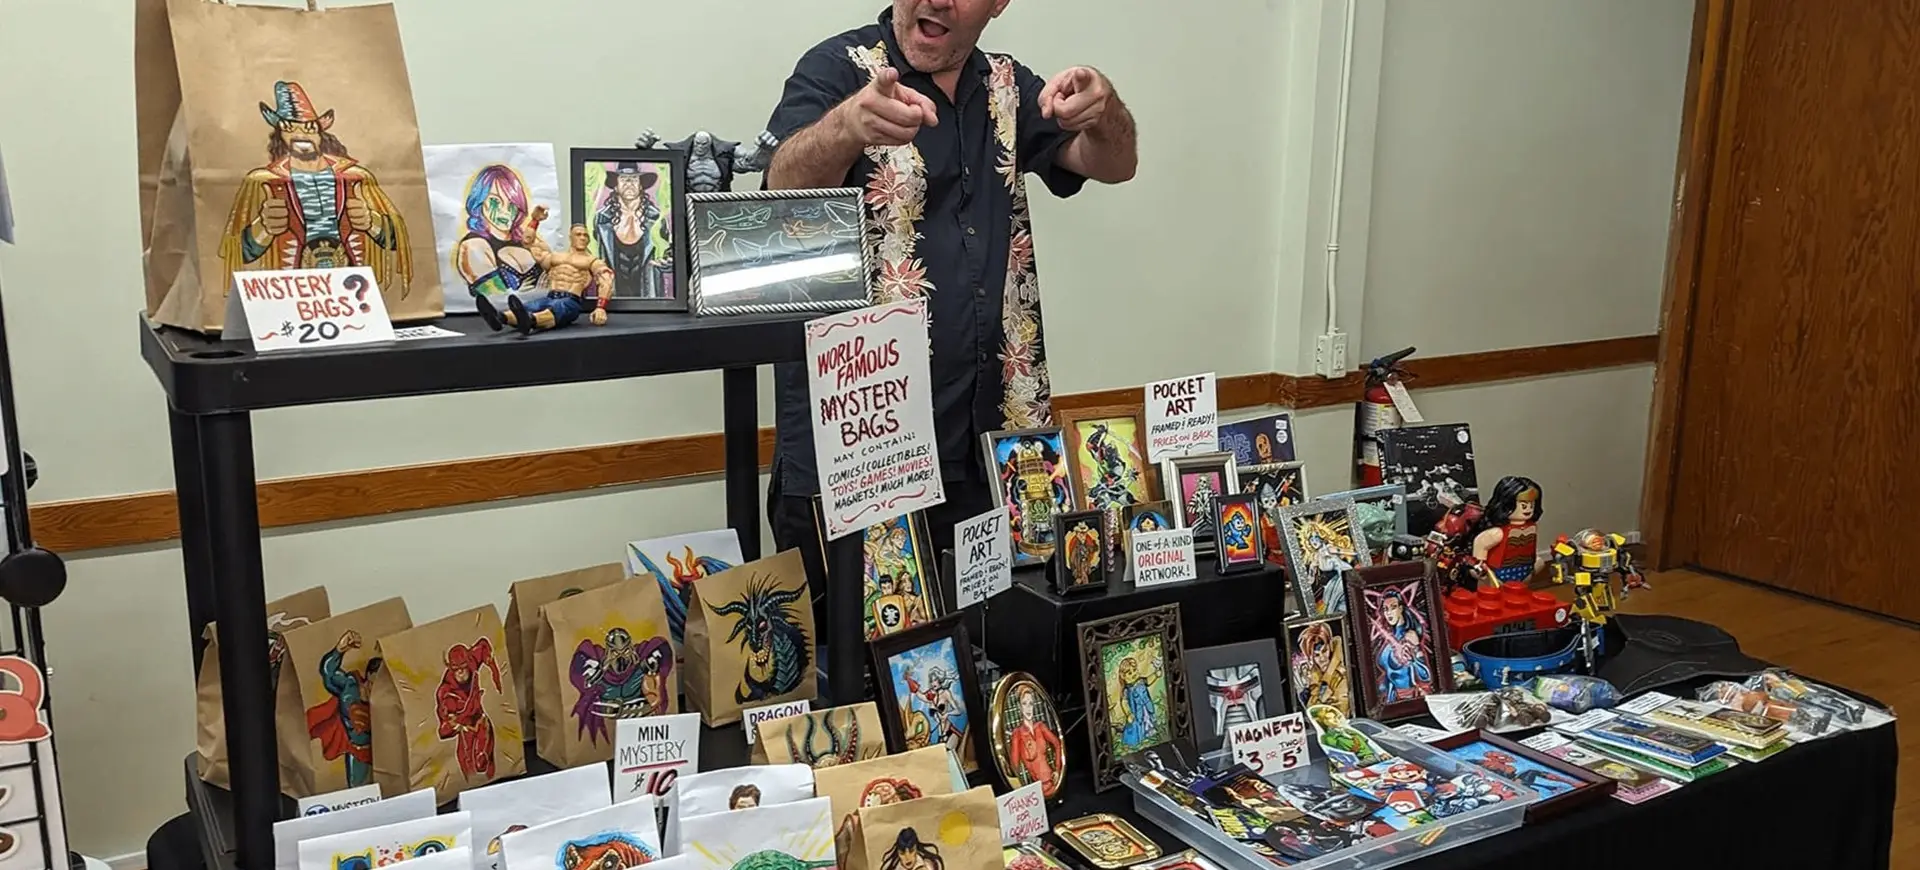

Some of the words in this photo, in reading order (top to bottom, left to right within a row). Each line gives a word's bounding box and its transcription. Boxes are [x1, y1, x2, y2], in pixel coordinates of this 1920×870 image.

[242, 273, 332, 301] MYSTERY
[297, 296, 354, 321] BAGS
[817, 336, 865, 378] WORLD
[837, 338, 900, 391] FAMOUS
[820, 375, 909, 426] MYSTERY
[1153, 376, 1205, 400] POCKET
[1165, 397, 1197, 417] ART
[840, 410, 900, 447] BAGS
[1151, 421, 1181, 435] FRAMED
[1187, 413, 1215, 428] READY!
[833, 451, 855, 465] MAY
[861, 431, 916, 457] CONTAIN:
[1153, 434, 1178, 448] PRICES
[1192, 430, 1214, 441] BACK
[828, 462, 865, 487] COMICS!
[866, 443, 931, 473] COLLECTIBLES!
[831, 478, 859, 498] TOYS!
[860, 467, 897, 489] GAMES!
[898, 455, 933, 476] MOVIES!
[834, 484, 879, 511] MAGNETS!
[880, 480, 904, 494] MUCH
[906, 468, 934, 485] MORE!
[962, 514, 1003, 546] POCKET
[969, 537, 996, 564] ART
[1136, 540, 1153, 552] ONE
[1163, 538, 1170, 548] A
[1172, 535, 1192, 547] KIND
[1138, 550, 1186, 568] ORIGINAL
[1139, 564, 1191, 582] ARTWORK!
[749, 703, 804, 726] DRAGON
[638, 724, 669, 742] MINI
[1234, 717, 1303, 745] MAGNETS
[620, 740, 686, 765] MYSTERY
[1003, 792, 1039, 815] THANKS
[1016, 810, 1031, 823] FOR
